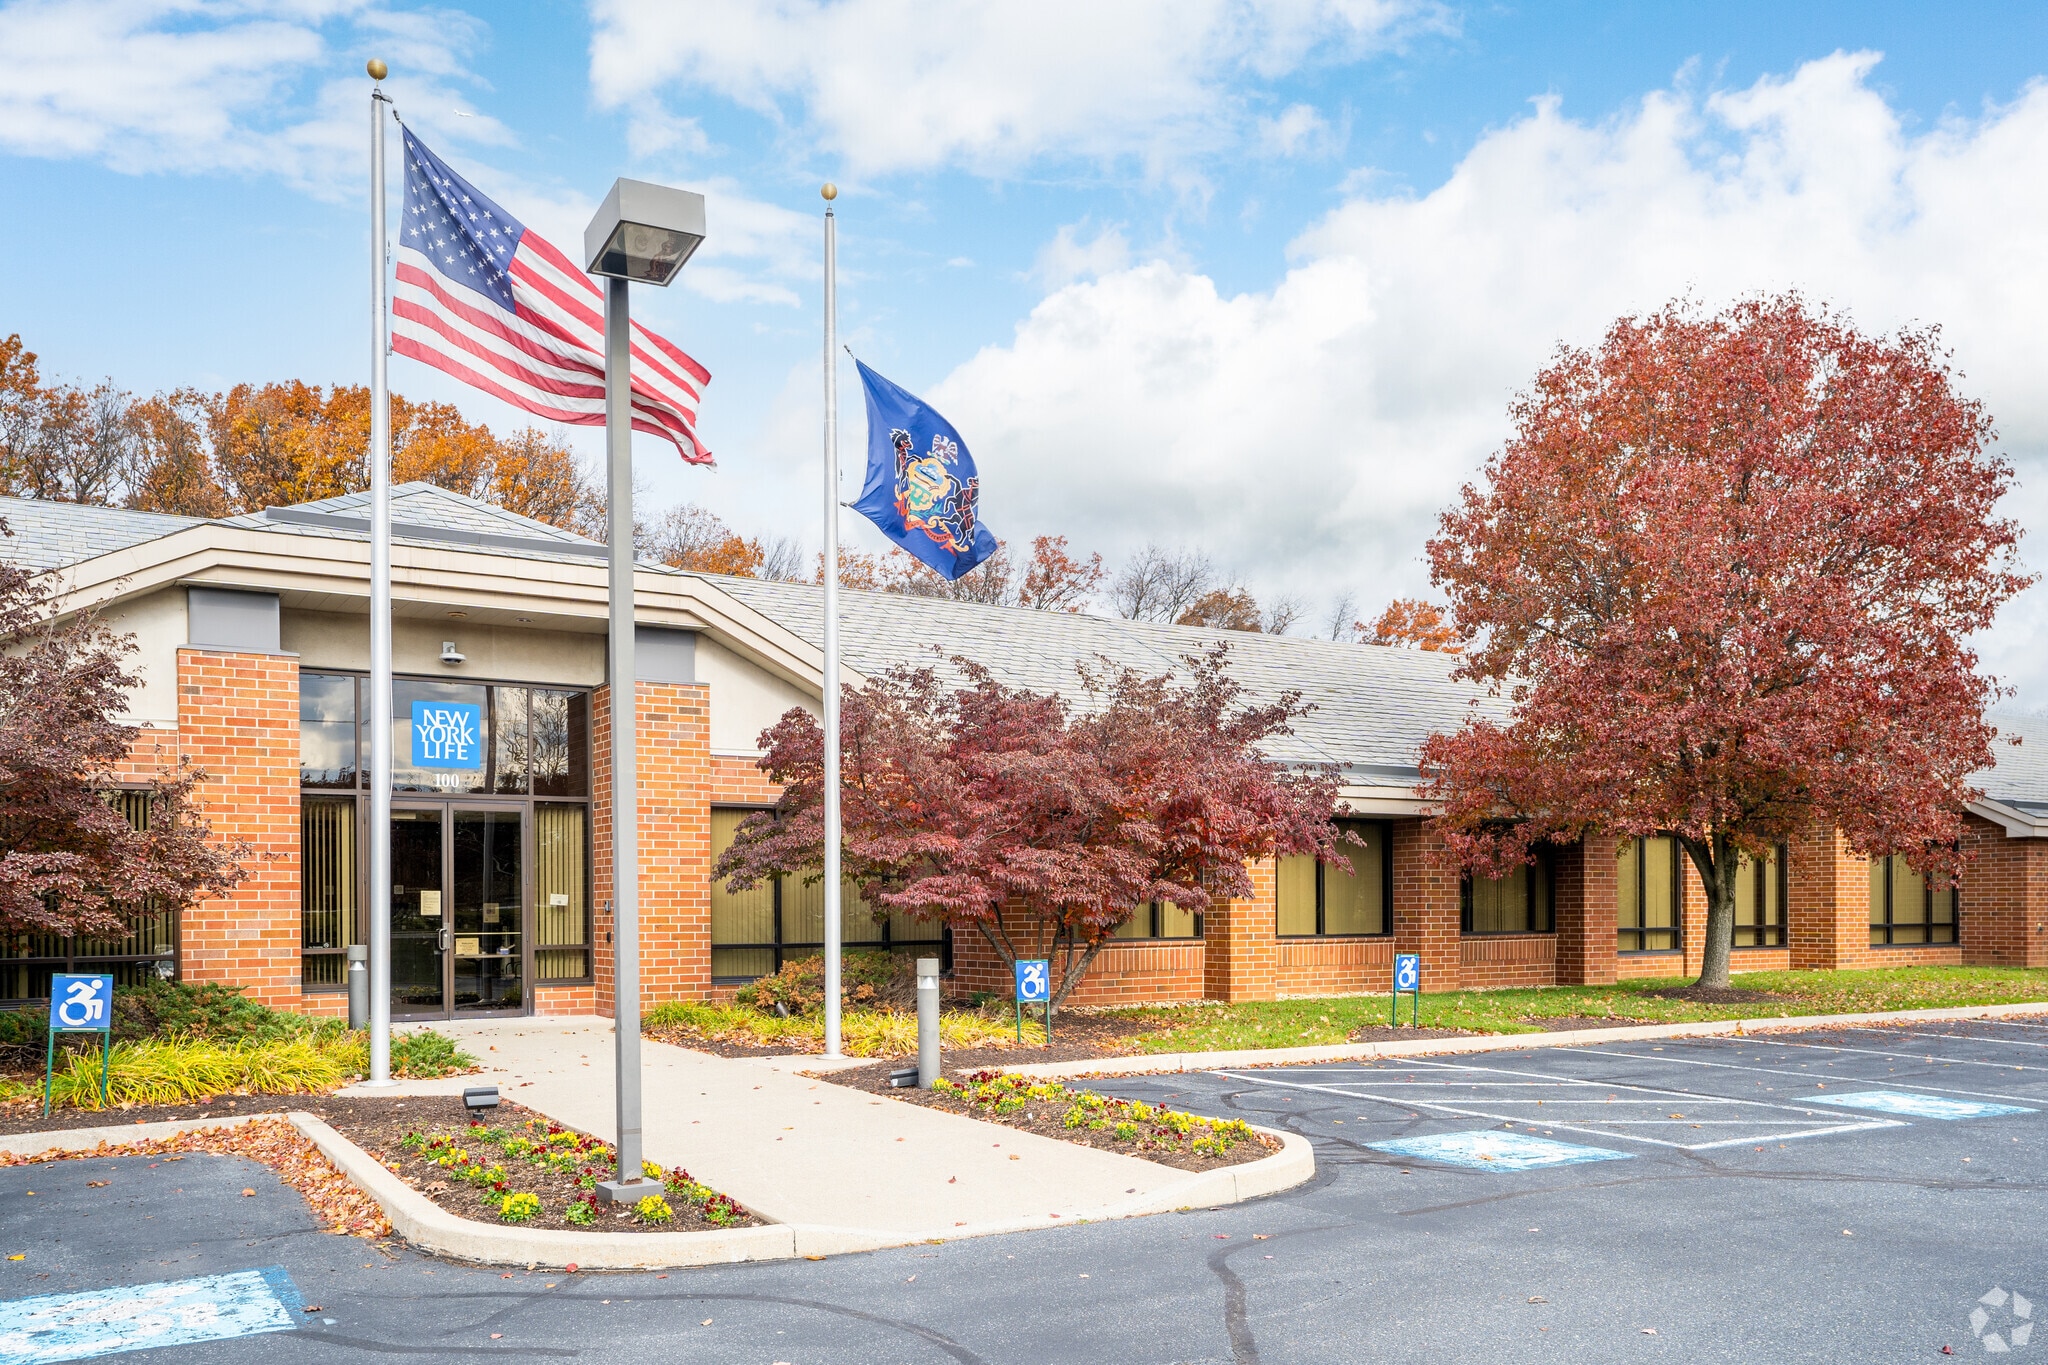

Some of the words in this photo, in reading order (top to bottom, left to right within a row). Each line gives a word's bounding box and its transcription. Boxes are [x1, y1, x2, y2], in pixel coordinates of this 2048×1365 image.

[423, 709, 470, 728] NEW
[415, 724, 475, 745] YORK
[424, 741, 469, 760] LIFE
[435, 773, 460, 788] 100
